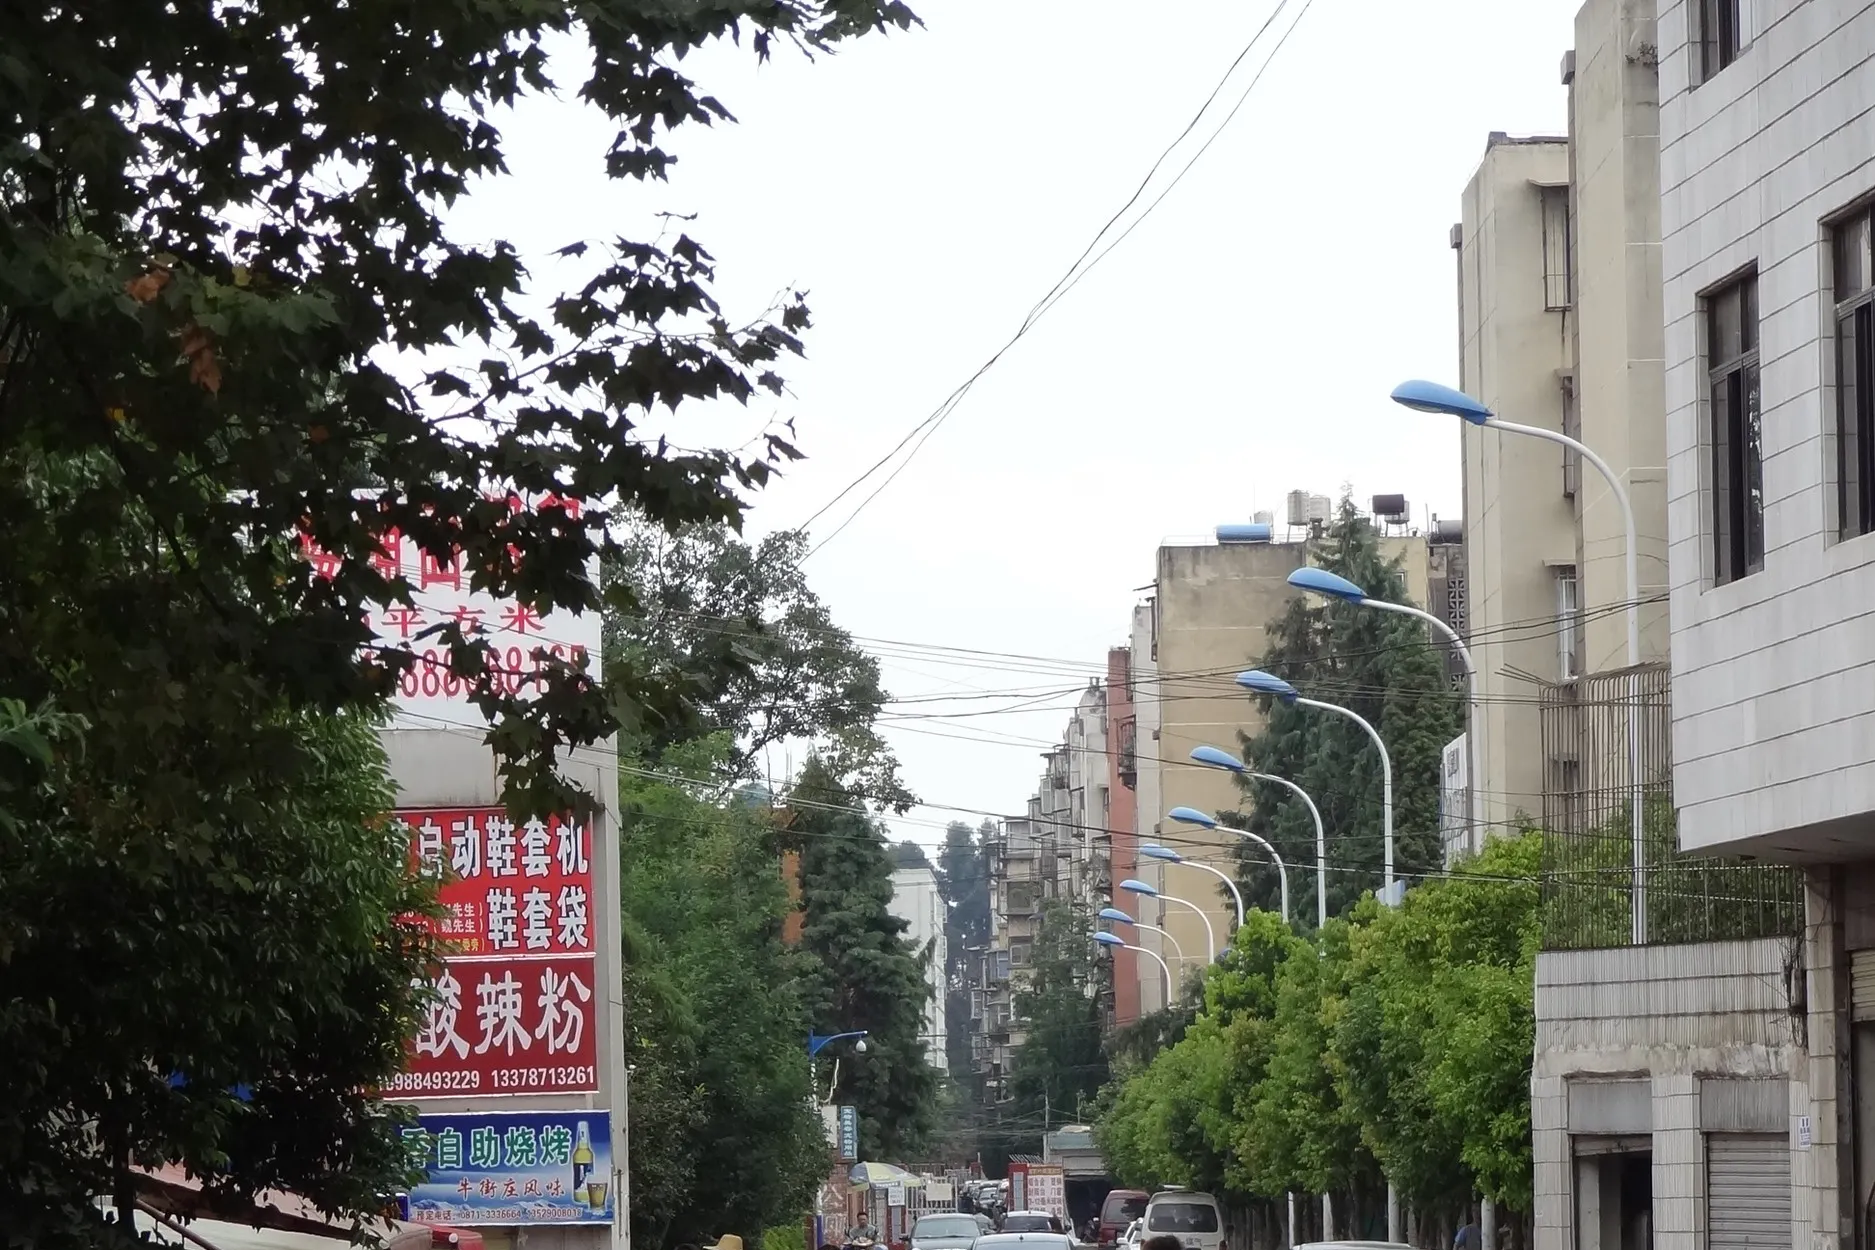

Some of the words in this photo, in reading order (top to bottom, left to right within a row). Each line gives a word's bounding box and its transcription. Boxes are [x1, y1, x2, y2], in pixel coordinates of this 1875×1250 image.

[396, 814, 590, 880] 自动鞋套机
[486, 885, 590, 950] 鞋套袋
[410, 966, 592, 1060] 酸辣粉
[491, 1066, 594, 1088] 13378713261
[457, 1177, 566, 1201] 牛街庄风味
